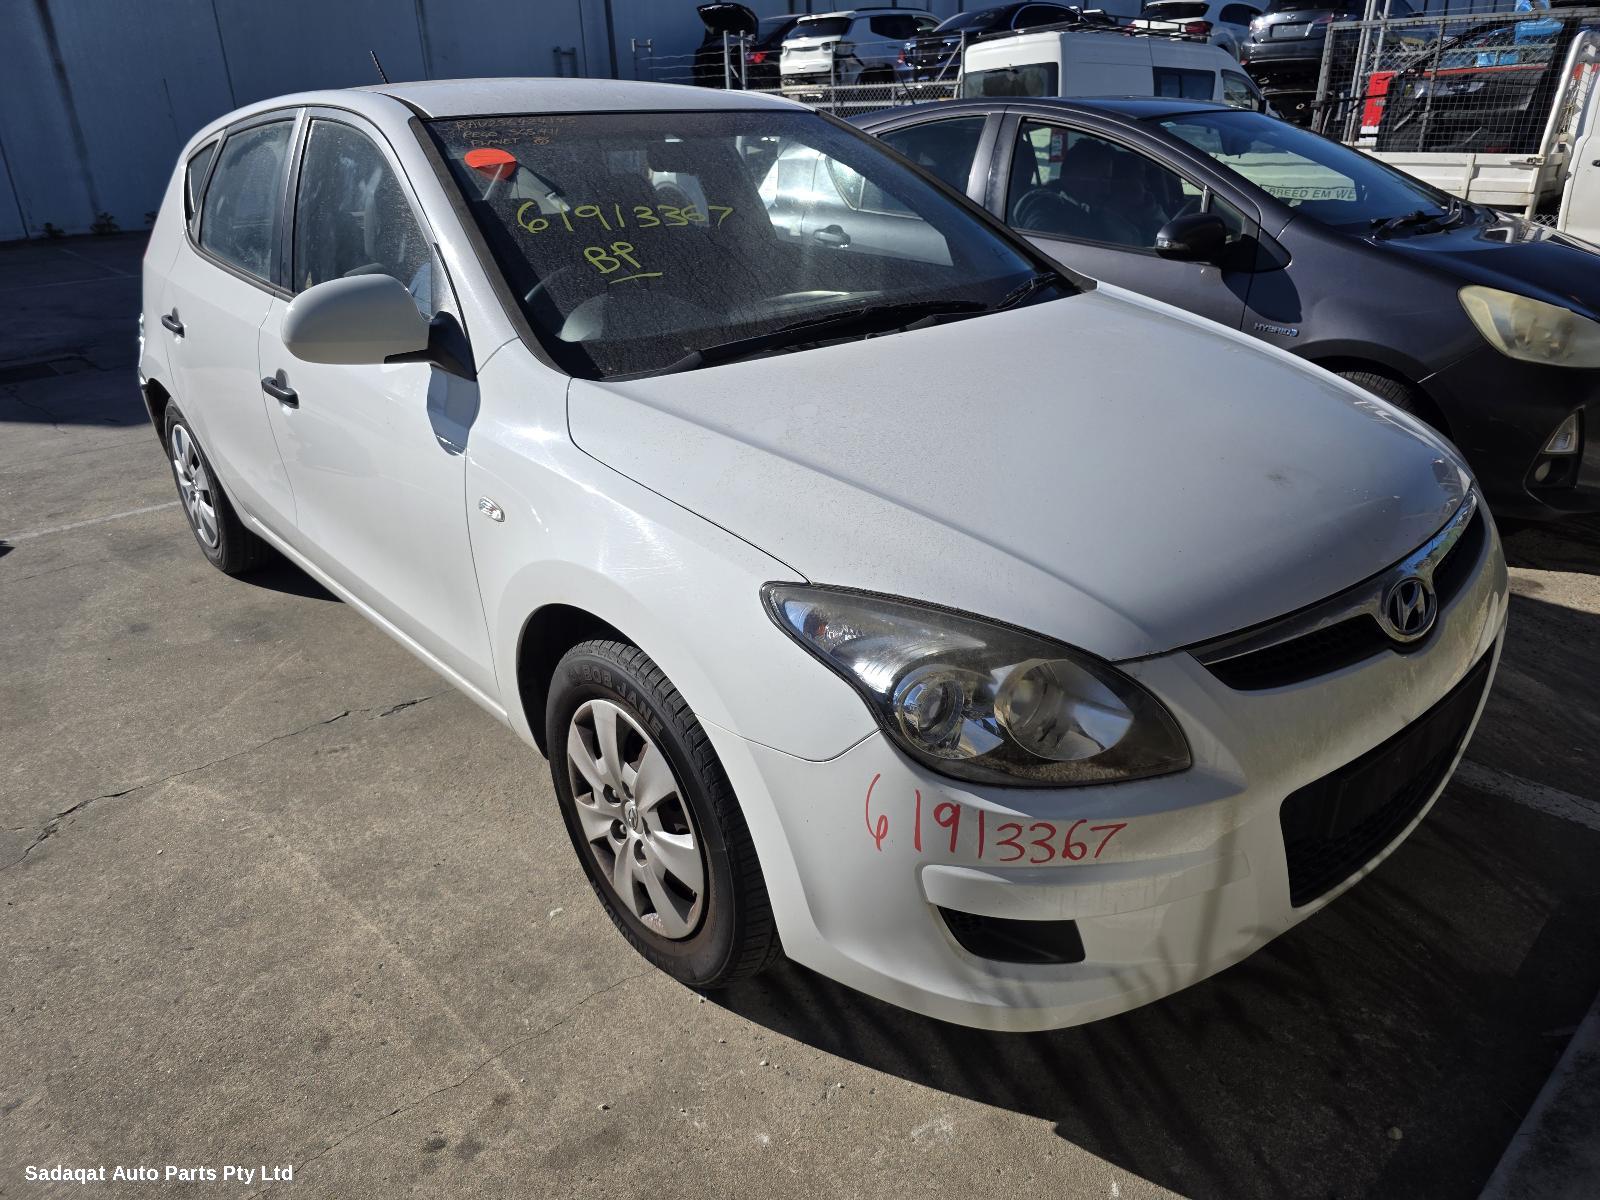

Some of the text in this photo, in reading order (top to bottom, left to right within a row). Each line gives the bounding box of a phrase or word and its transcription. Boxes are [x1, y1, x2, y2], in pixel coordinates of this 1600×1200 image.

[1312, 189, 1331, 199] EM
[516, 200, 735, 234] 61913367
[1254, 322, 1291, 336] HYBRID
[865, 773, 1128, 864] 61913367
